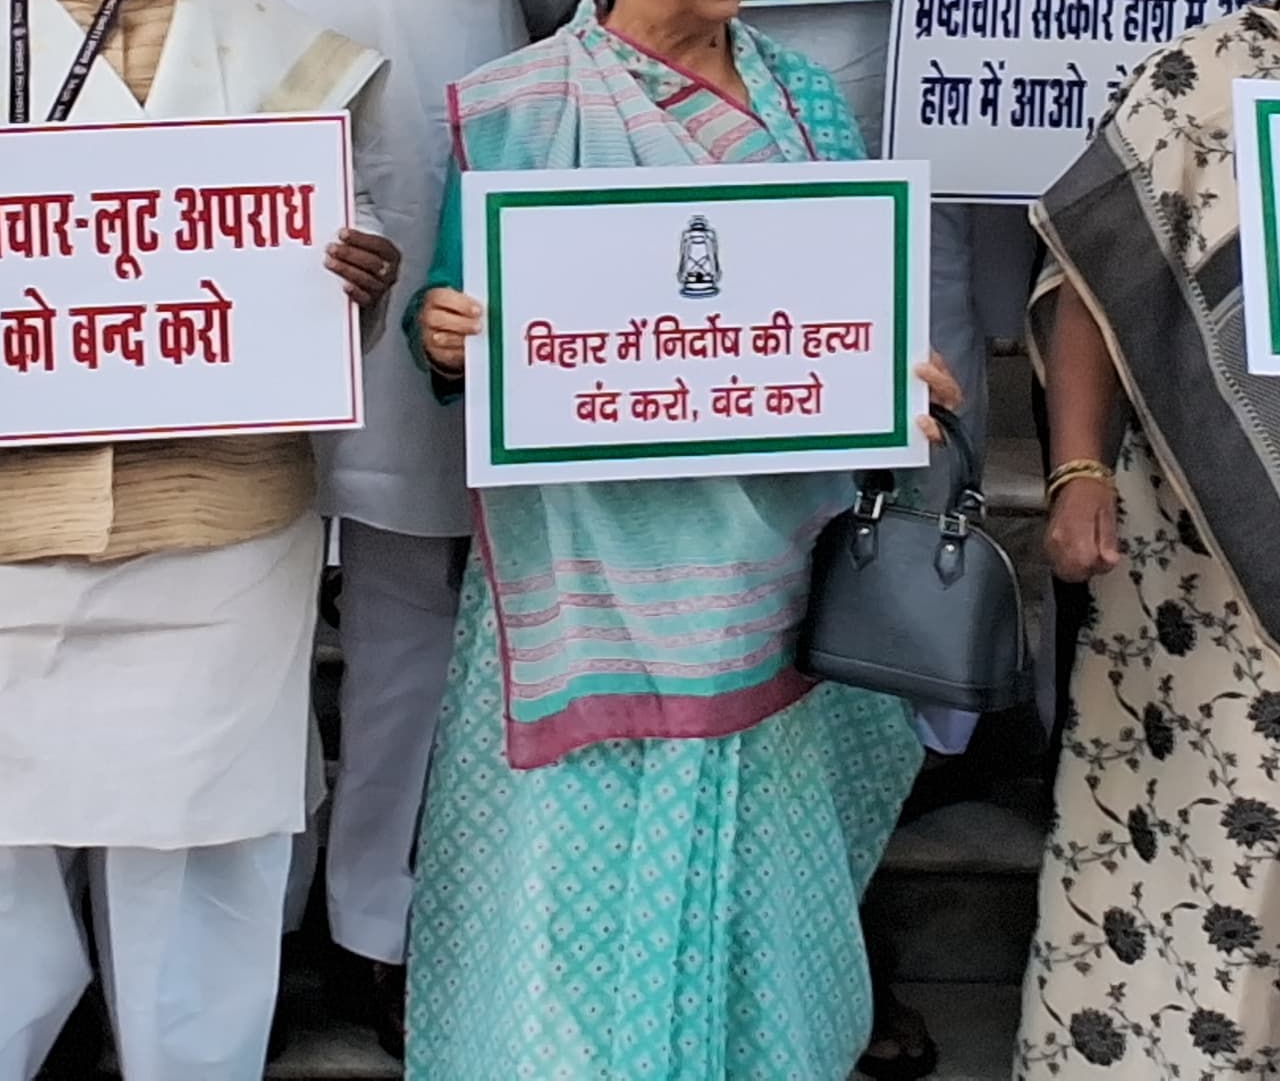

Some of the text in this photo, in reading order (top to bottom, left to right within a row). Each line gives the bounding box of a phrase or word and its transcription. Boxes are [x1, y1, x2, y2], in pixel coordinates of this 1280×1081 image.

[922, 60, 973, 127] होश
[980, 61, 1006, 126] में
[1011, 63, 1095, 141] आओ,
[174, 184, 315, 250] अपराध
[0, 279, 232, 372] को बन्द करो
[525, 310, 872, 368] बिहार में निर्दोष की हत्या
[575, 372, 823, 422] बंद करो, बंद करो
